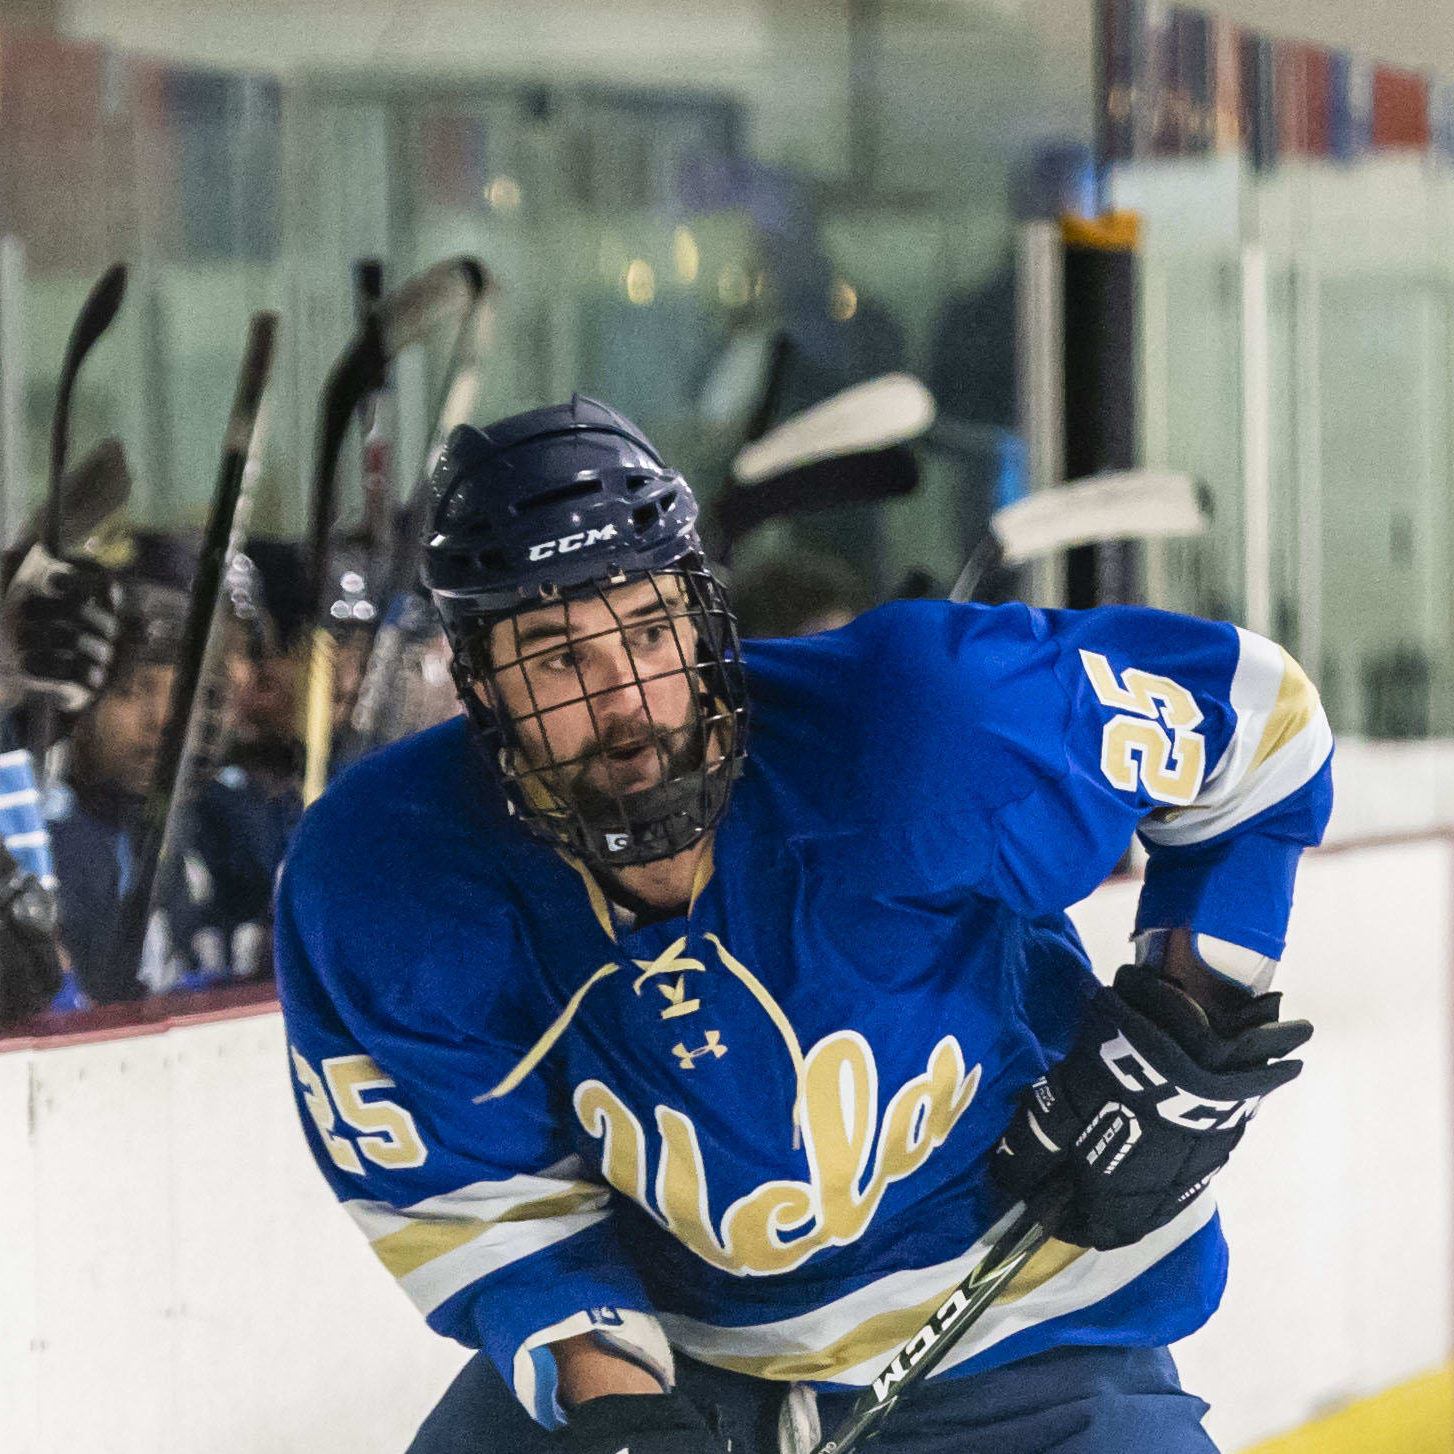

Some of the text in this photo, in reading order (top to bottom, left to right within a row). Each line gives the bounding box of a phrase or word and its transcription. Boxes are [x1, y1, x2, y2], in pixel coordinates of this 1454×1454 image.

[528, 523, 618, 561] CCM
[1078, 649, 1206, 806] 25
[290, 1045, 428, 1176] 25
[872, 1288, 972, 1402] CCM
